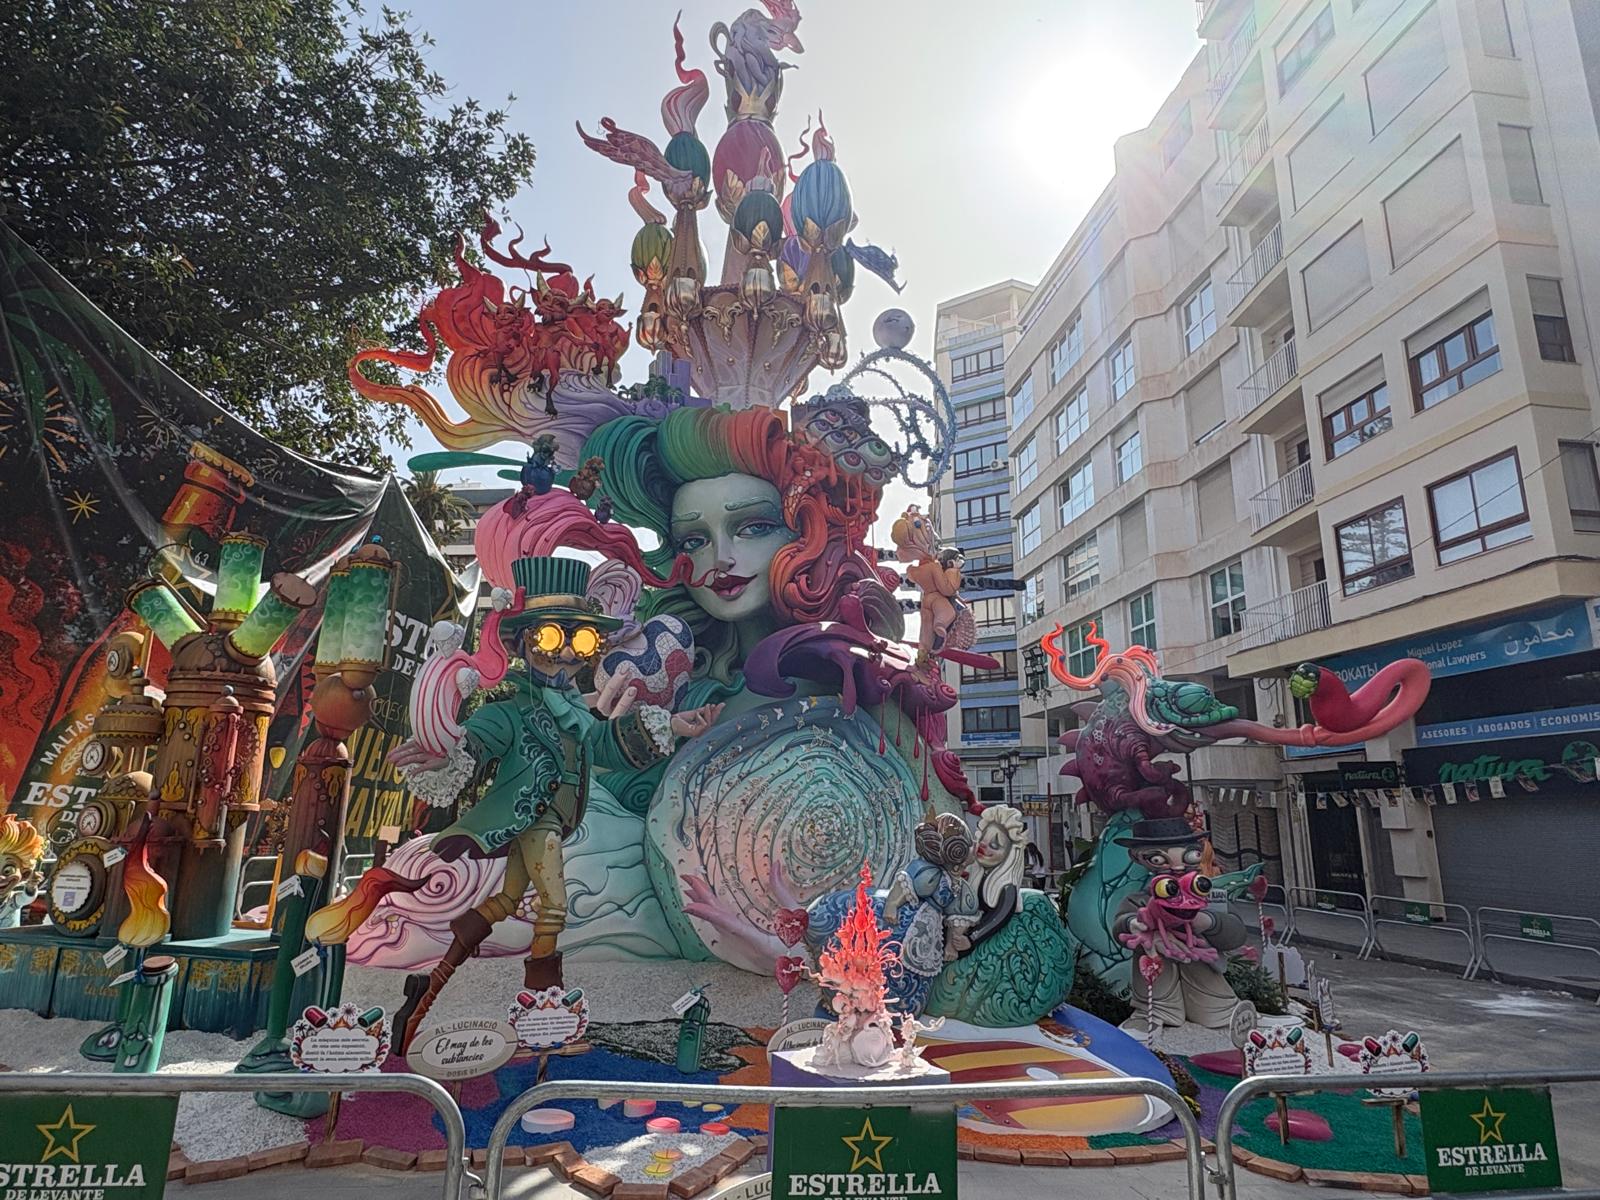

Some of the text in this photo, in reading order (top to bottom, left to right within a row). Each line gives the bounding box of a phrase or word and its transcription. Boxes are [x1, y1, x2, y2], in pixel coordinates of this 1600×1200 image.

[1407, 638, 1463, 658] Miguel Lopez
[1447, 650, 1486, 666] Lawyers
[40, 713, 96, 766] MALTAS
[1421, 726, 1467, 740] ASESORES
[1477, 719, 1531, 733] ABOGADOS
[1439, 755, 1553, 783] natura
[1436, 1142, 1548, 1167] ESTRELLA
[1465, 1163, 1525, 1176] DE LEVANTE
[29, 1188, 105, 1200] LEVANTE
[788, 1172, 942, 1196] ESTRELLA
